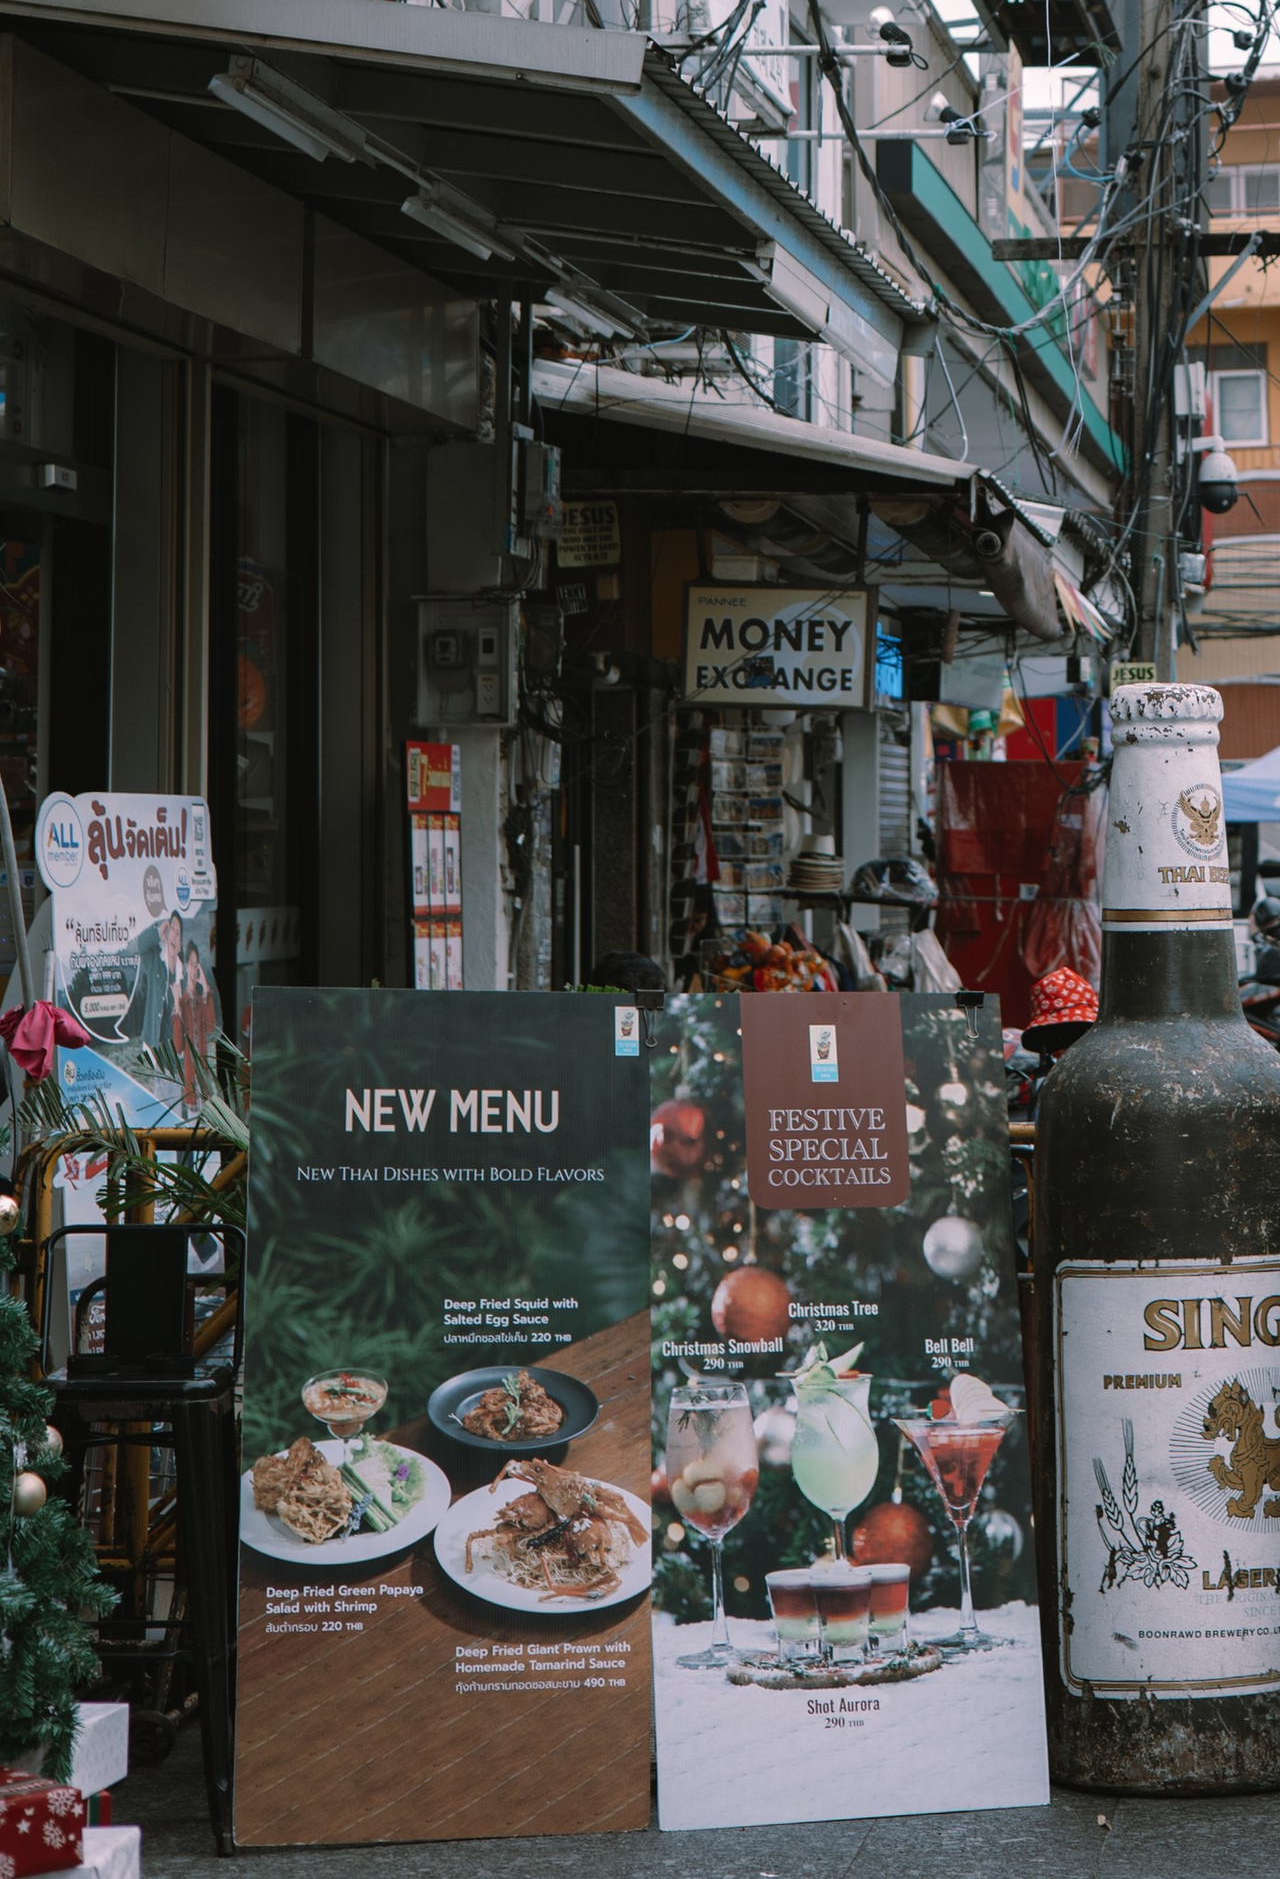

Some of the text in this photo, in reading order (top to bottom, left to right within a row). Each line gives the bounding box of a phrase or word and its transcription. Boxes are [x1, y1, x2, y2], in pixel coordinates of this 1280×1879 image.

[698, 597, 747, 607] PANNEE
[700, 618, 853, 651] MONEY
[696, 665, 853, 691] EXCANGE
[1112, 666, 1154, 681] JESUS
[47, 822, 79, 848] ALL
[48, 851, 78, 862] member
[1158, 866, 1205, 883] THAI
[345, 1088, 560, 1132] NEW MENU
[768, 1108, 886, 1132] FESTIVE
[769, 1137, 888, 1162] SPECIAL
[768, 1167, 891, 1188] COCKTAILS
[444, 1297, 579, 1312] Deep Fried Squid with
[788, 1301, 879, 1318] Christmas Tree
[444, 1314, 549, 1327] Salted Egg Sauce
[814, 1319, 854, 1332] 320 THB
[531, 1333, 552, 1342] 220
[555, 1334, 572, 1342] THB
[662, 1337, 784, 1357] Christmas Snowball
[924, 1338, 974, 1353] Bell Bell
[703, 1358, 744, 1370] 290 THB
[931, 1356, 970, 1368] 290 THB
[1103, 1374, 1182, 1390] PREMIUM
[1203, 1568, 1276, 1591] LAGER
[266, 1584, 424, 1599] Deep Fried Green Papaya
[265, 1600, 378, 1615] Salad with Shrimp
[321, 1622, 343, 1631] 220
[346, 1622, 363, 1631] THB
[1139, 1628, 1202, 1640] BOONRAWD
[1205, 1628, 1255, 1638] BREWERY
[455, 1641, 631, 1659] Deep Fried Giant Prawn with
[455, 1658, 626, 1673] Homemade Tamarind Sauce
[584, 1677, 606, 1688] 490
[609, 1678, 626, 1687] THB
[807, 1696, 880, 1716] Shot Aurora
[824, 1716, 864, 1729] 290 THB
